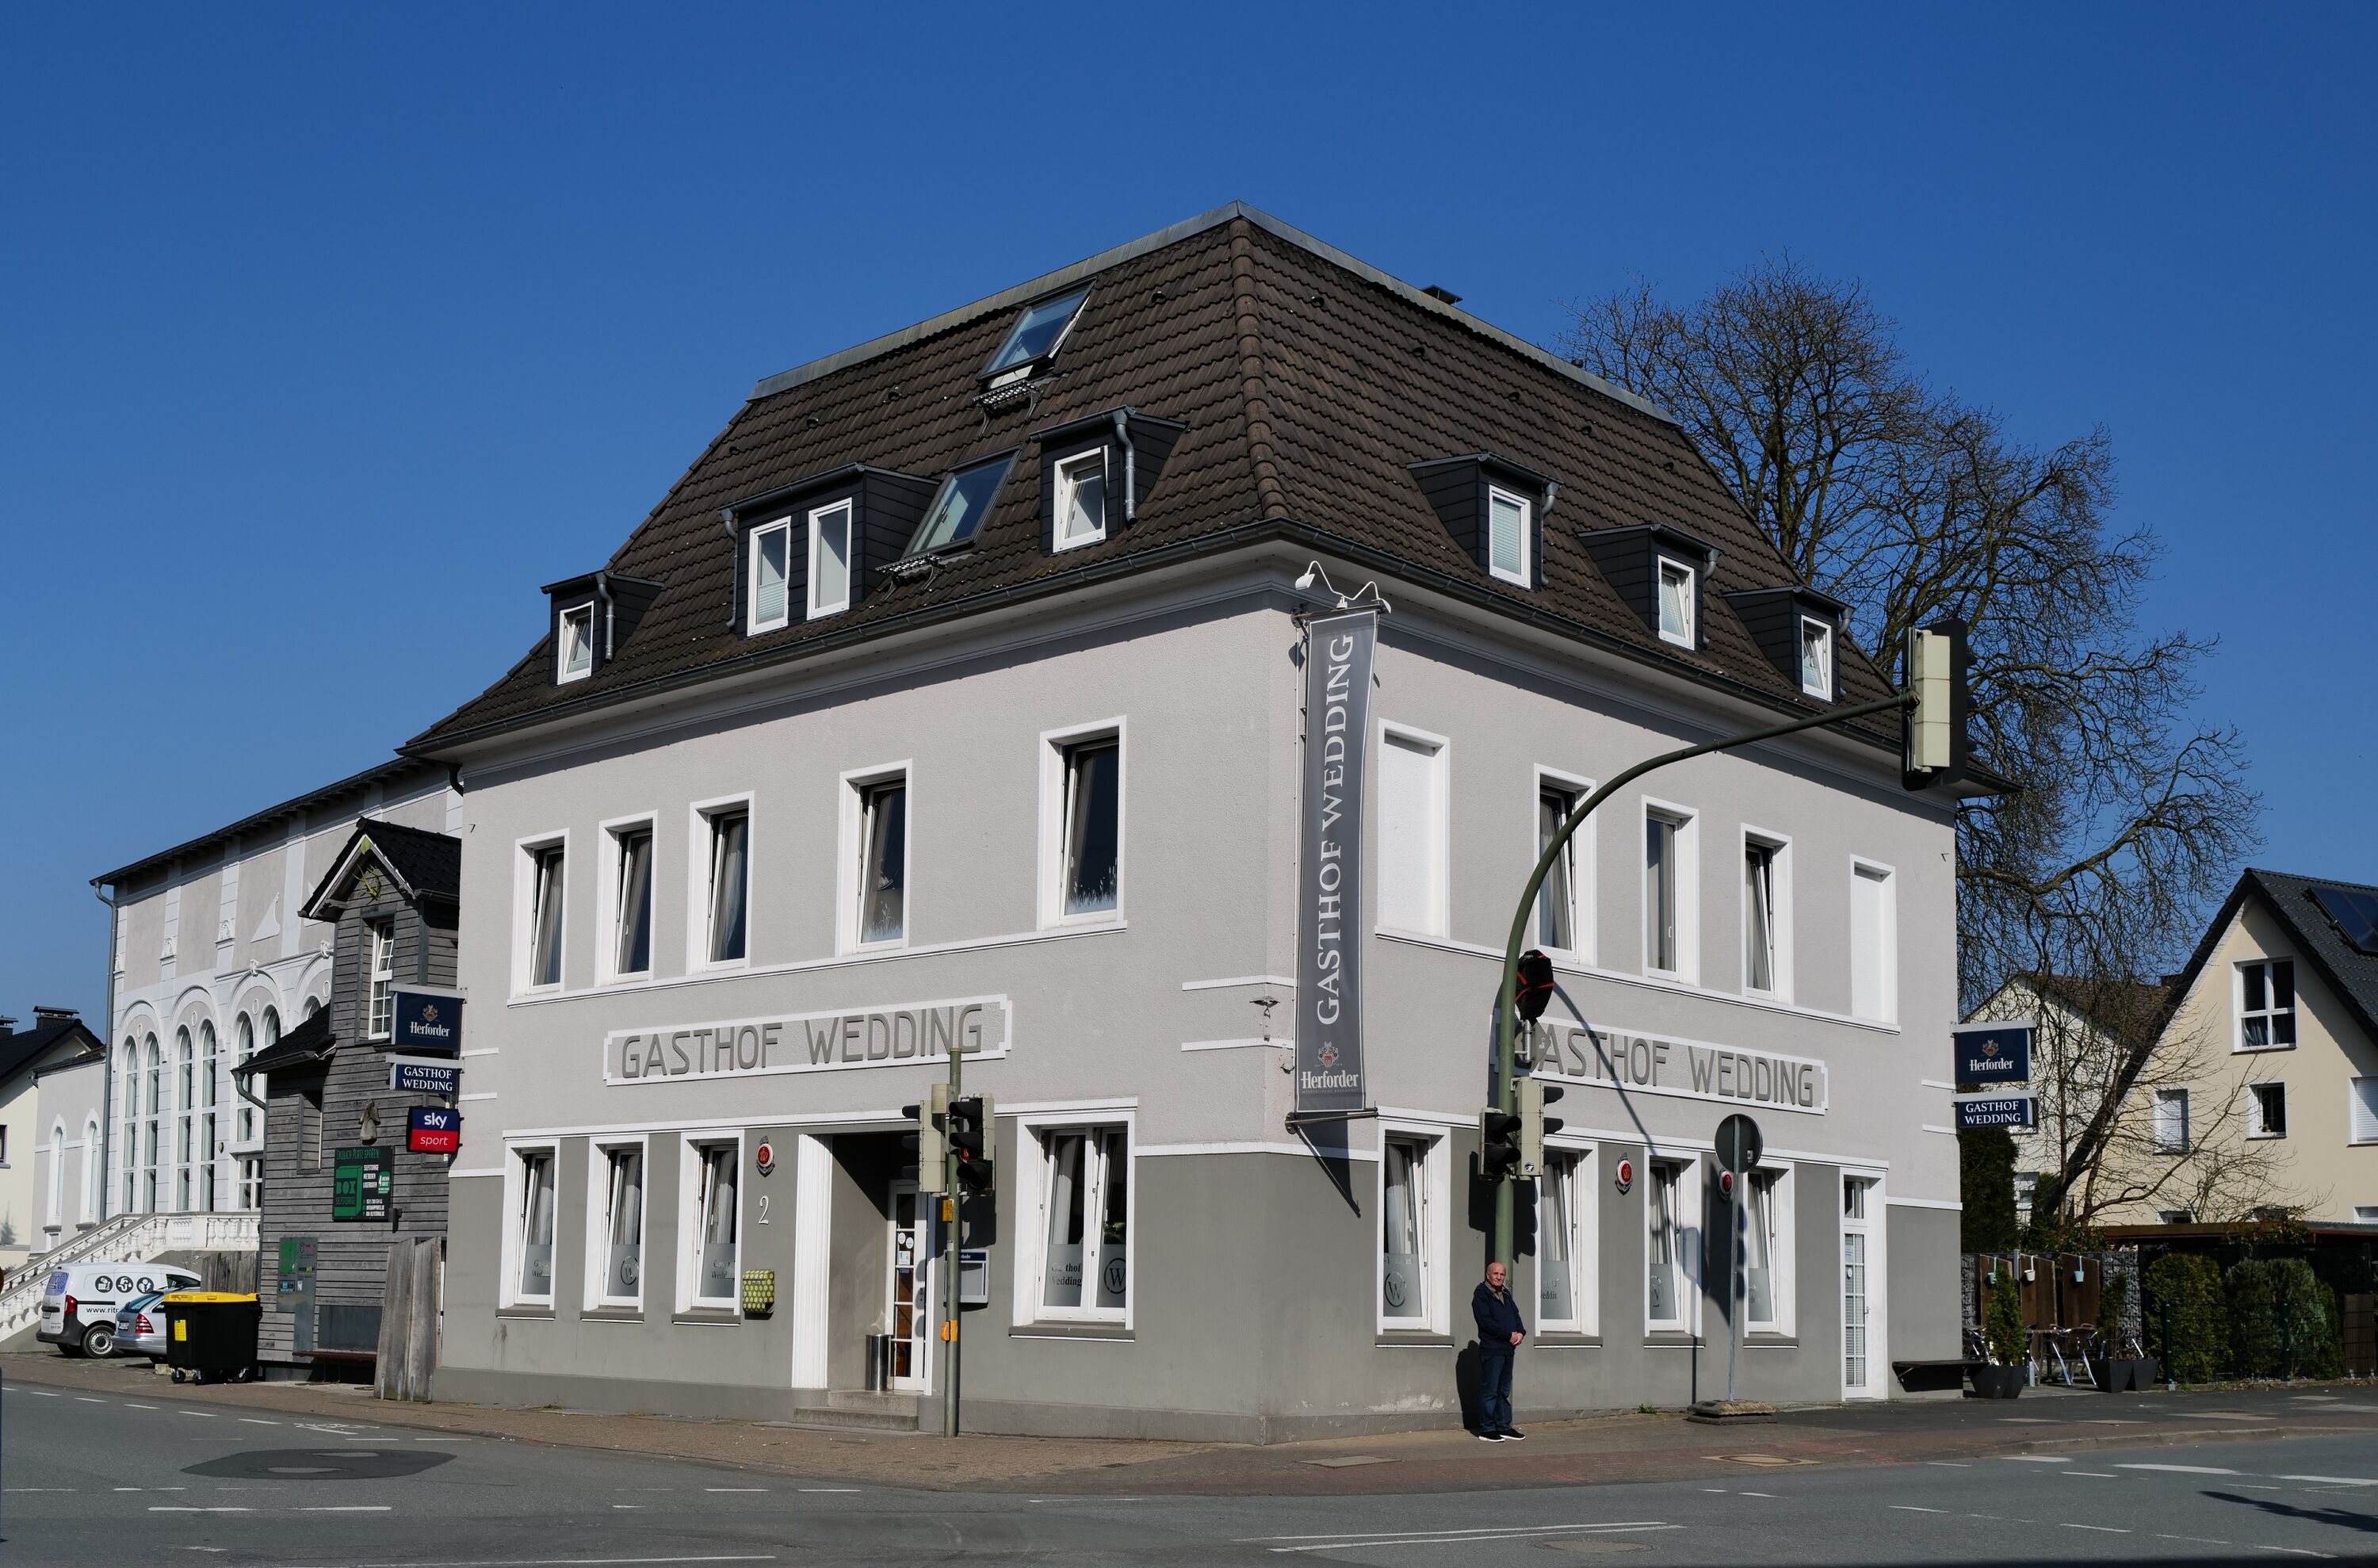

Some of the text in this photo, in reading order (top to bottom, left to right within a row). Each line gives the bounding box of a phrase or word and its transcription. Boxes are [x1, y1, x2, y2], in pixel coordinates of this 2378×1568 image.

[1317, 635, 1353, 1025] GASTHOF WEDDING
[410, 1021, 450, 1037] Herforder
[621, 1004, 982, 1078] GASTHOF WEDDING
[1537, 1023, 1813, 1107] ASTHOF WEDDING
[1969, 1057, 2014, 1072] Herforder
[404, 1066, 452, 1079] GASTHOF
[1301, 1070, 1359, 1089] Herforder
[403, 1078, 453, 1092] WEDDING
[1966, 1101, 2019, 1113] GASTHOF
[424, 1112, 447, 1129] sky
[1964, 1113, 2021, 1124] WEDDING
[420, 1136, 448, 1146] sport
[335, 1181, 356, 1194] BOX
[378, 1175, 382, 1187] 4
[759, 1195, 769, 1225] 2
[1109, 1268, 1126, 1287] W
